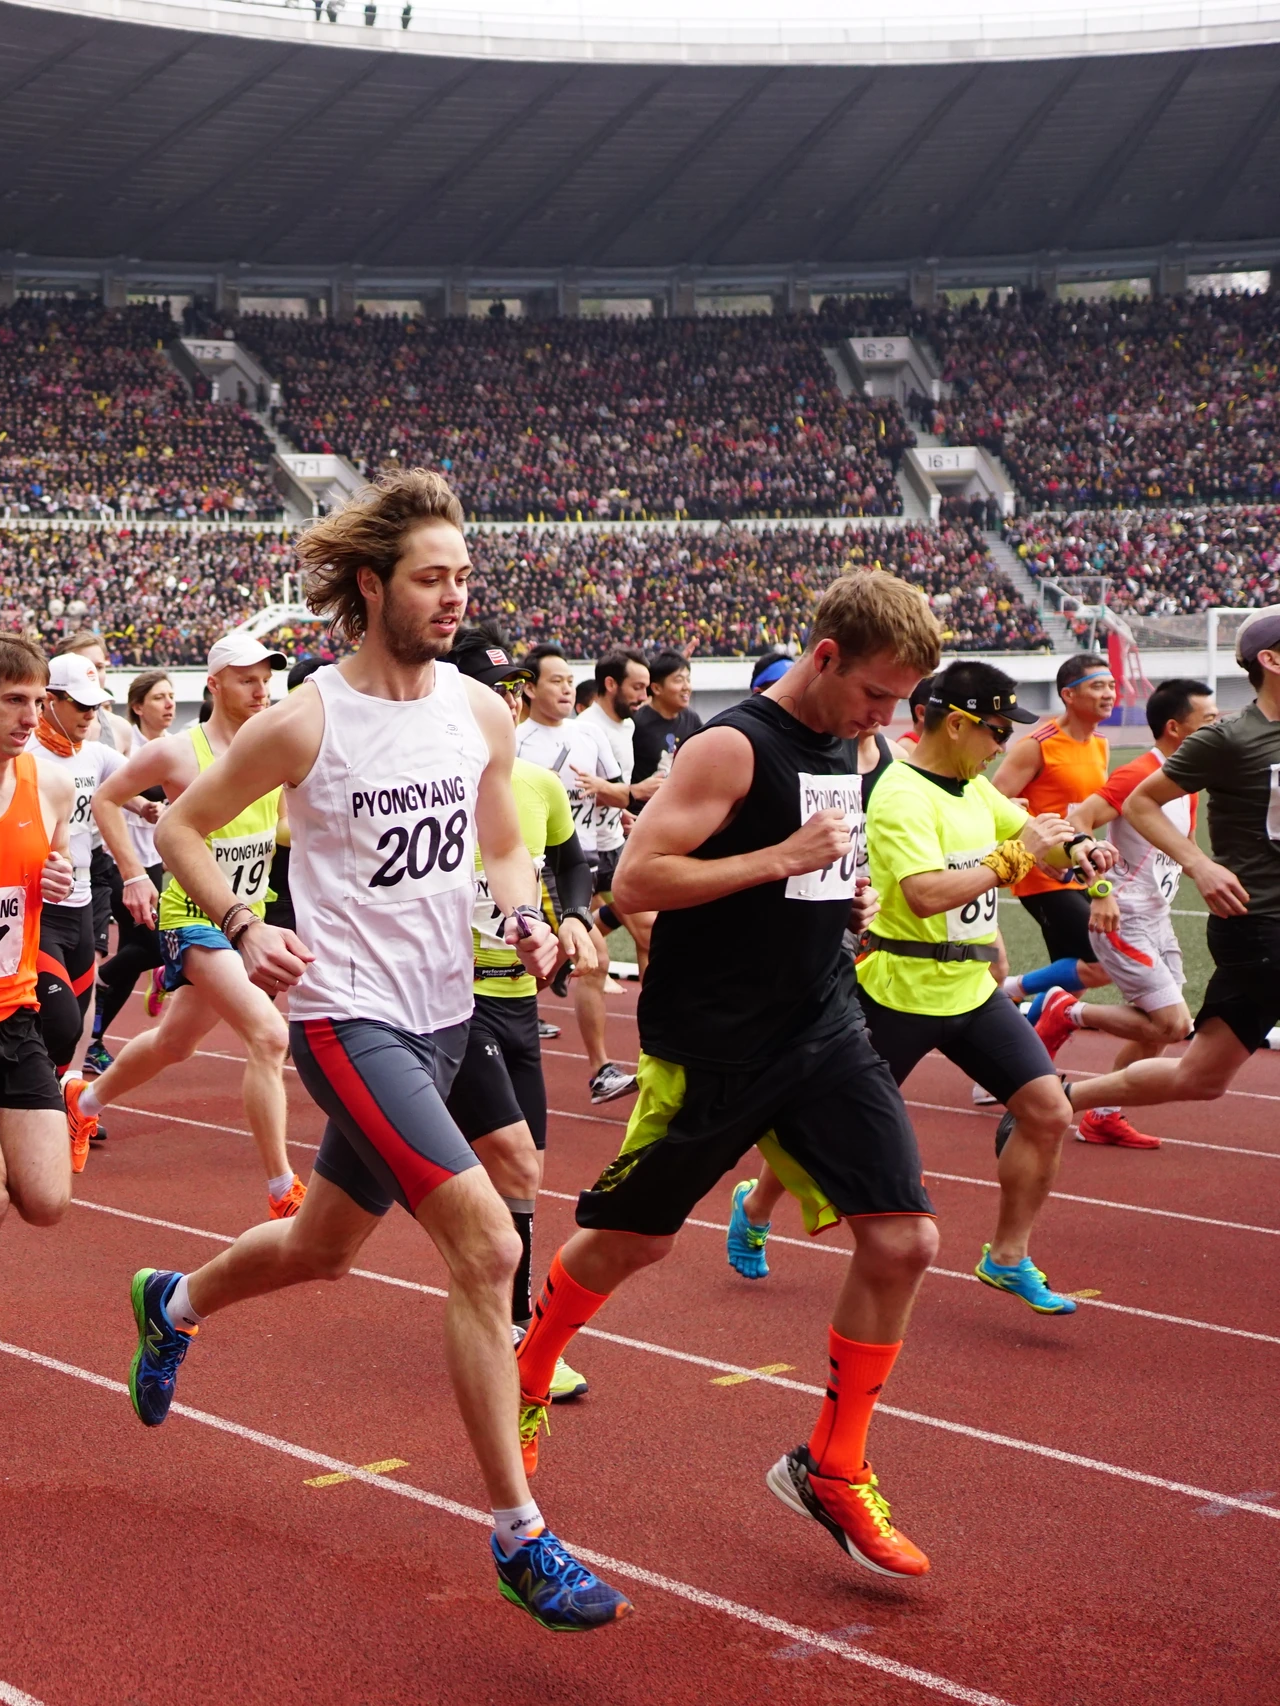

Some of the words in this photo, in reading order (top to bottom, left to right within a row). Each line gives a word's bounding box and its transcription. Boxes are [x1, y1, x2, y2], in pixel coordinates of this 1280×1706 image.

[862, 342, 895, 358] 16-2
[928, 453, 960, 468] 16-1
[352, 775, 466, 818] PYONGYANG
[215, 840, 273, 862] PYONGYANG
[367, 808, 468, 888] 208
[231, 860, 265, 896] 19
[481, 968, 517, 976] performance
